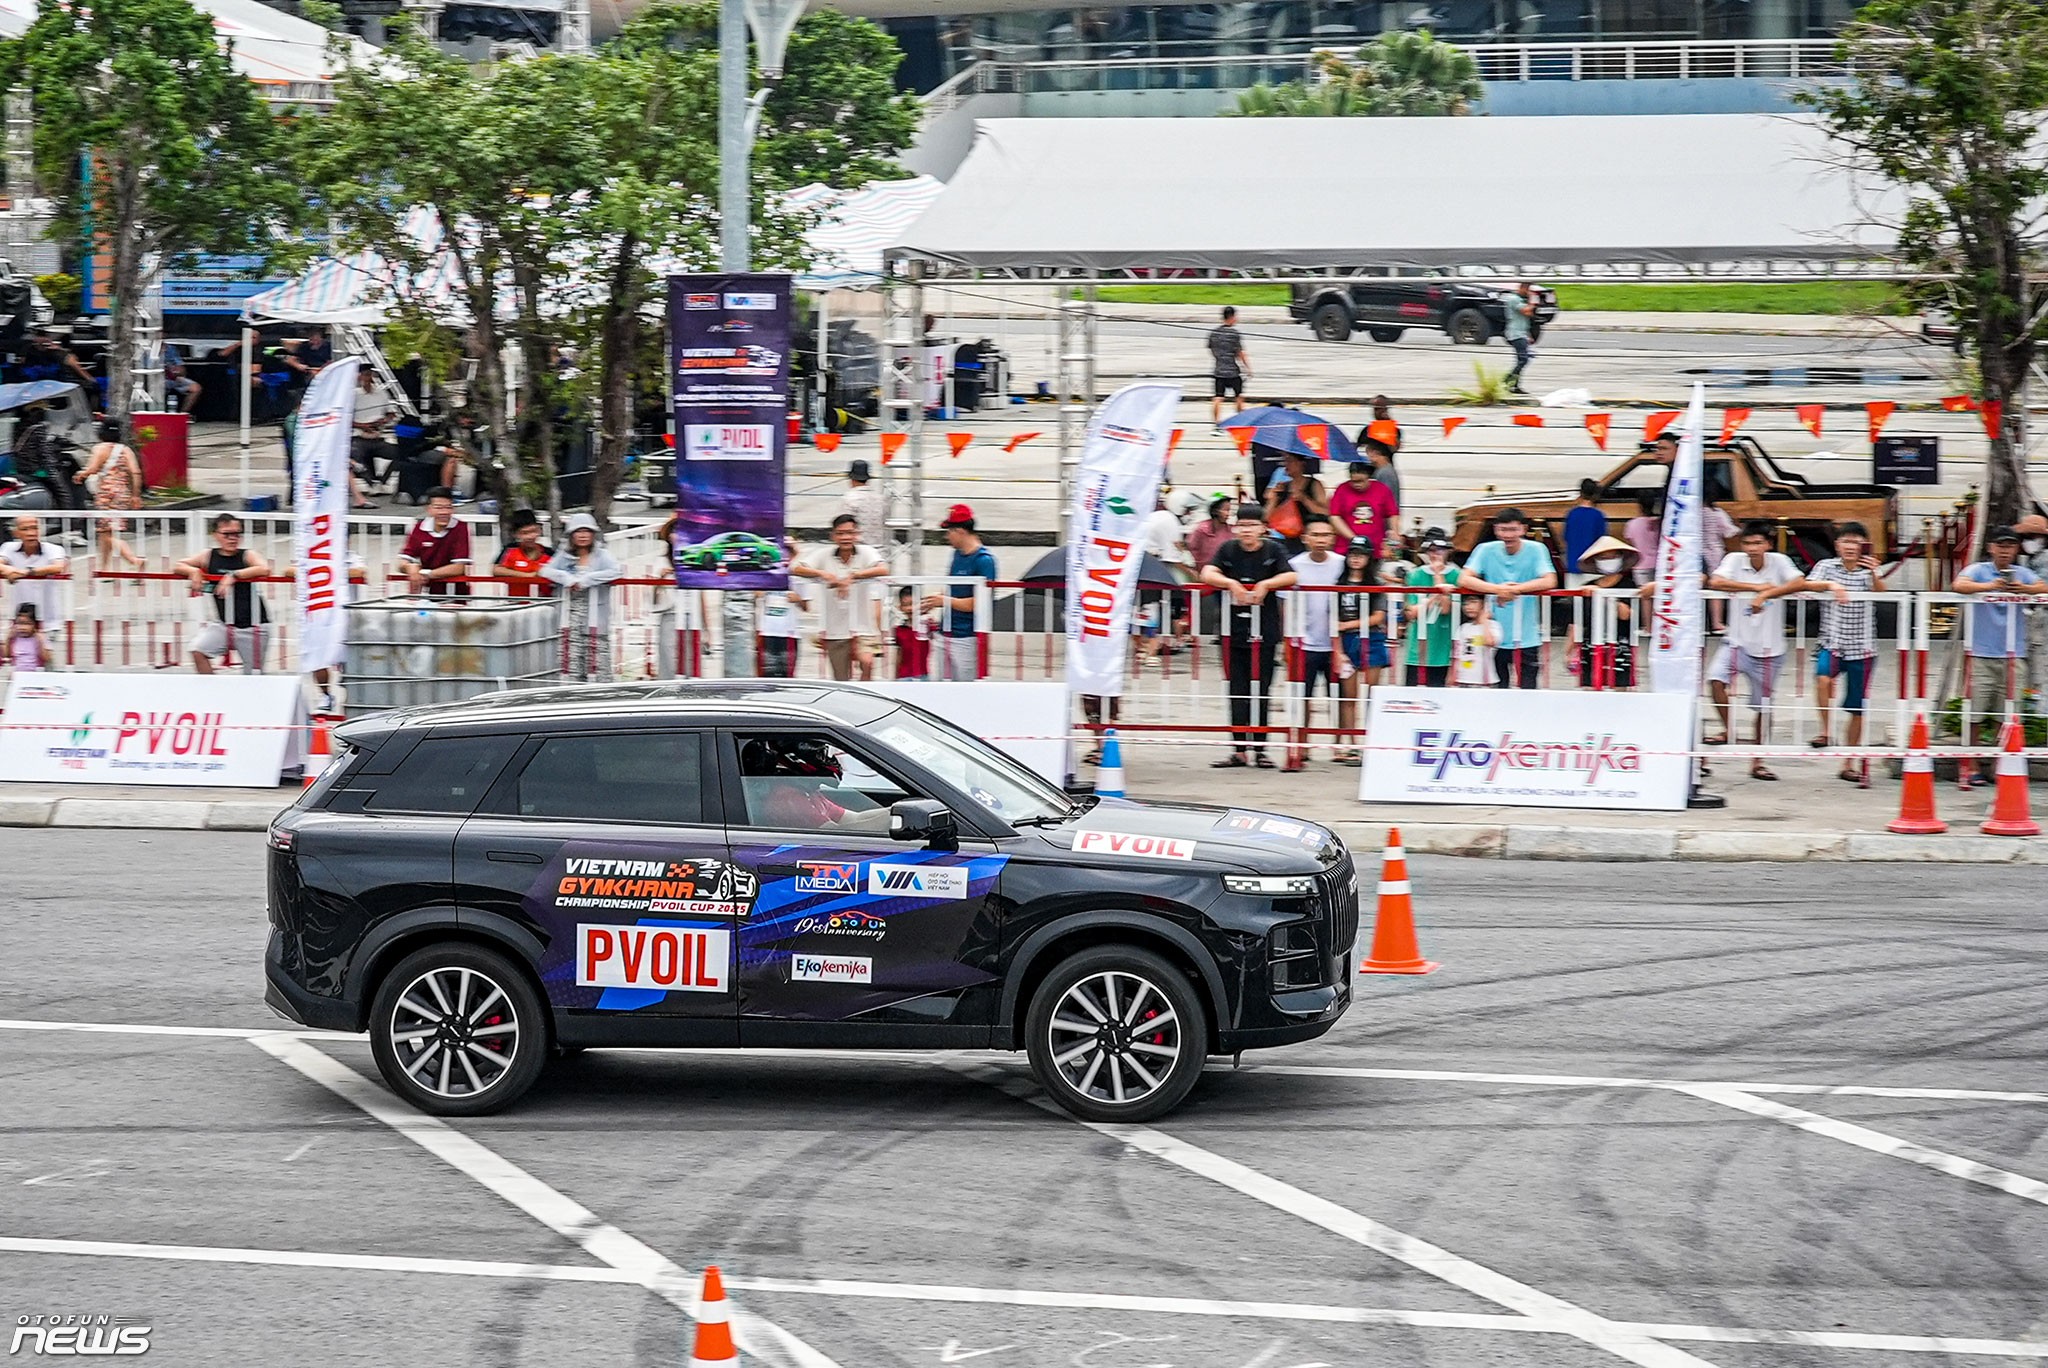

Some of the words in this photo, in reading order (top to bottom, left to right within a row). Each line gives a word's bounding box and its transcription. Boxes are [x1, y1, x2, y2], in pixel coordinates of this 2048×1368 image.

[1079, 537, 1132, 643] PVOIL
[114, 711, 229, 756] PVOIL
[1412, 728, 1642, 785] Ekokemika
[1080, 832, 1185, 858] PVOIL
[565, 858, 666, 878] VIETNAM
[558, 876, 695, 899] GYMKHANA
[800, 876, 855, 893] MEDIA
[555, 897, 649, 910] CHAMPIONSHIP
[651, 901, 687, 912] PVOIL
[690, 902, 715, 913] CUP
[718, 903, 747, 914] 2025
[812, 922, 886, 942] Anniversary
[586, 928, 719, 988] PVOIL
[796, 958, 868, 979] Ekokemika
